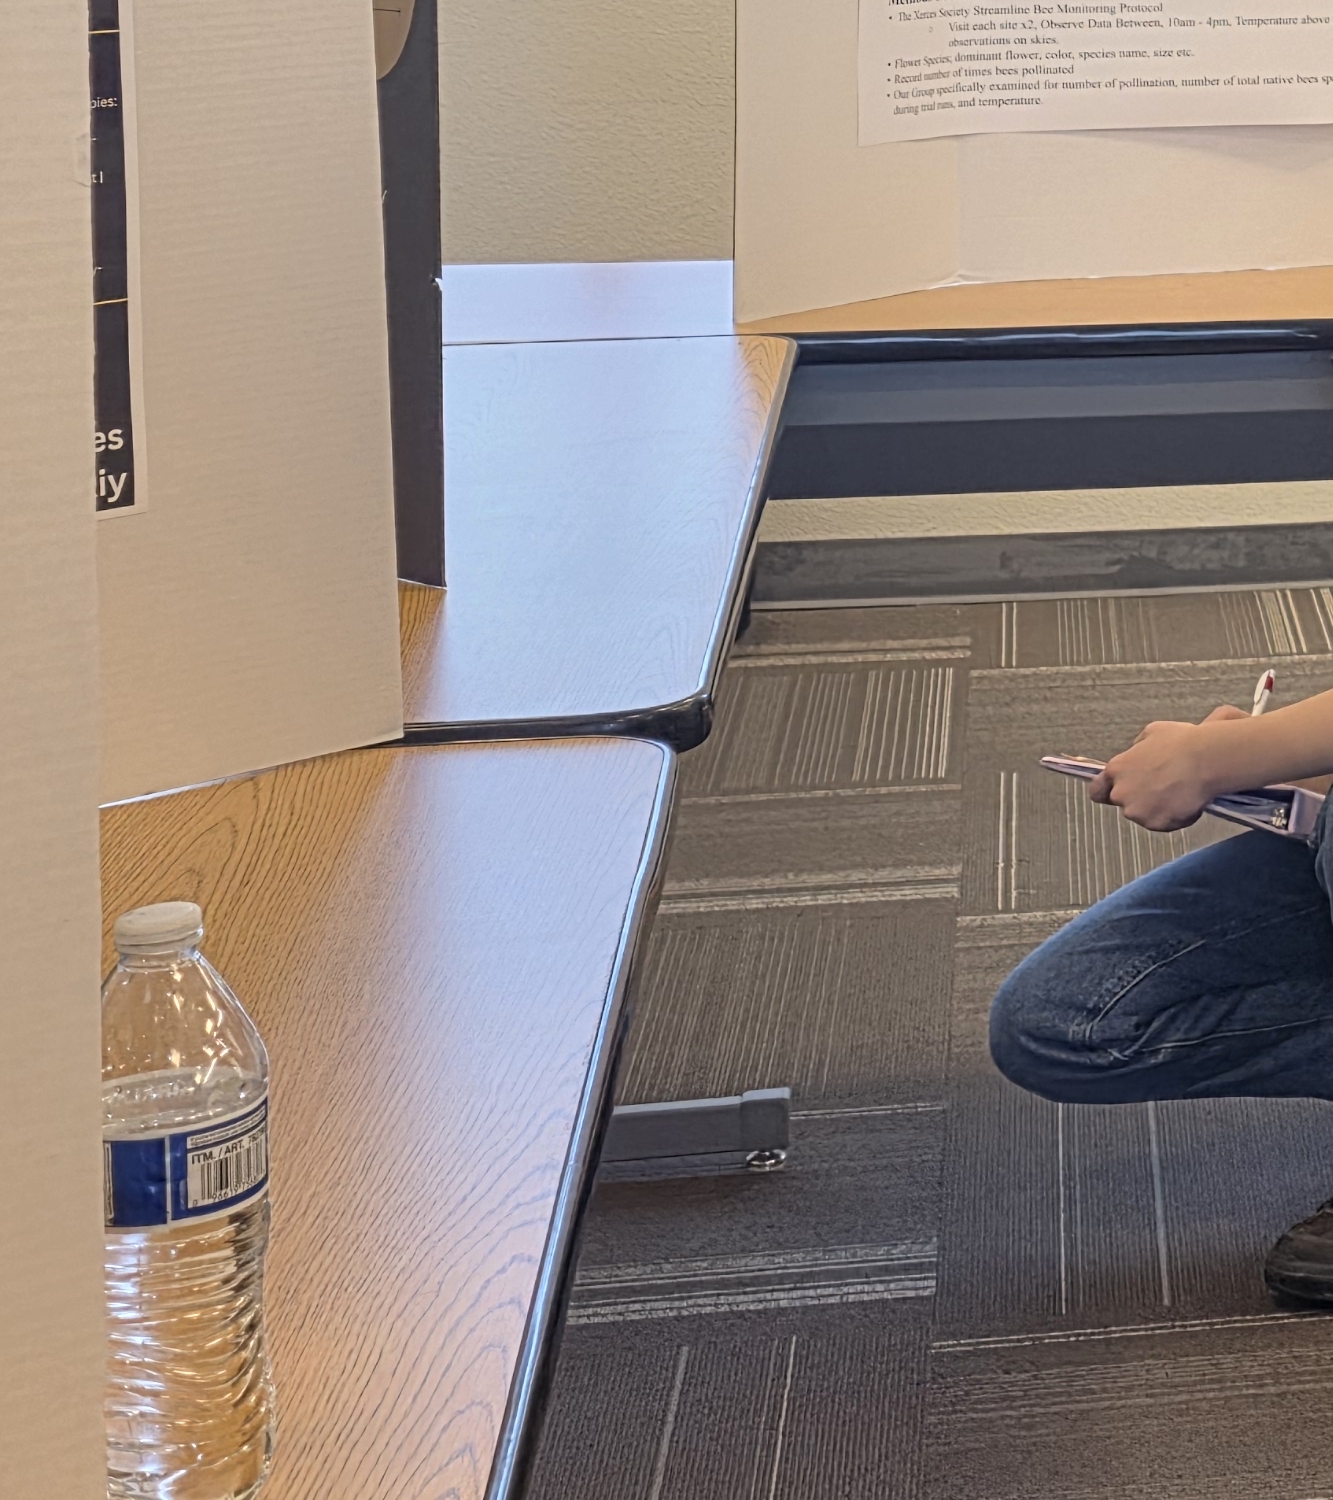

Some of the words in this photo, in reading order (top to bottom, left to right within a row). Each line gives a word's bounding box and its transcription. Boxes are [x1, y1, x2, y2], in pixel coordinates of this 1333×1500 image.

[974, 5, 1029, 16] Streamline
[1033, 4, 1054, 14] Bee
[1057, 4, 1116, 15] Monitoring
[1120, 3, 1163, 13] Protocol
[949, 21, 969, 31] Visit
[973, 21, 996, 31] each
[1000, 20, 1017, 30] site
[1041, 20, 1083, 29] Observe
[1088, 19, 1111, 28] Data
[1168, 17, 1195, 27] 10am
[1235, 15, 1297, 27] Temperature
[1301, 15, 1329, 24] above
[949, 35, 1011, 47] observations
[1014, 36, 1027, 45] on
[1031, 35, 1059, 45] skies.
[955, 51, 1001, 62] dominant
[1079, 50, 1116, 59] species
[953, 67, 963, 77] of
[964, 67, 992, 76] times
[995, 67, 1018, 76] bees
[1022, 65, 1074, 77] pollinated
[937, 82, 986, 96] specifically
[989, 80, 1039, 91] examined
[1044, 80, 1058, 89] for
[1062, 80, 1101, 89] number
[1105, 78, 1117, 88] of
[1223, 76, 1235, 86] of
[1237, 75, 1260, 85] total
[1263, 75, 1294, 85] native
[958, 98, 975, 108] and
[192, 1151, 216, 1164] ITM.
[225, 1140, 244, 1155] ART.
